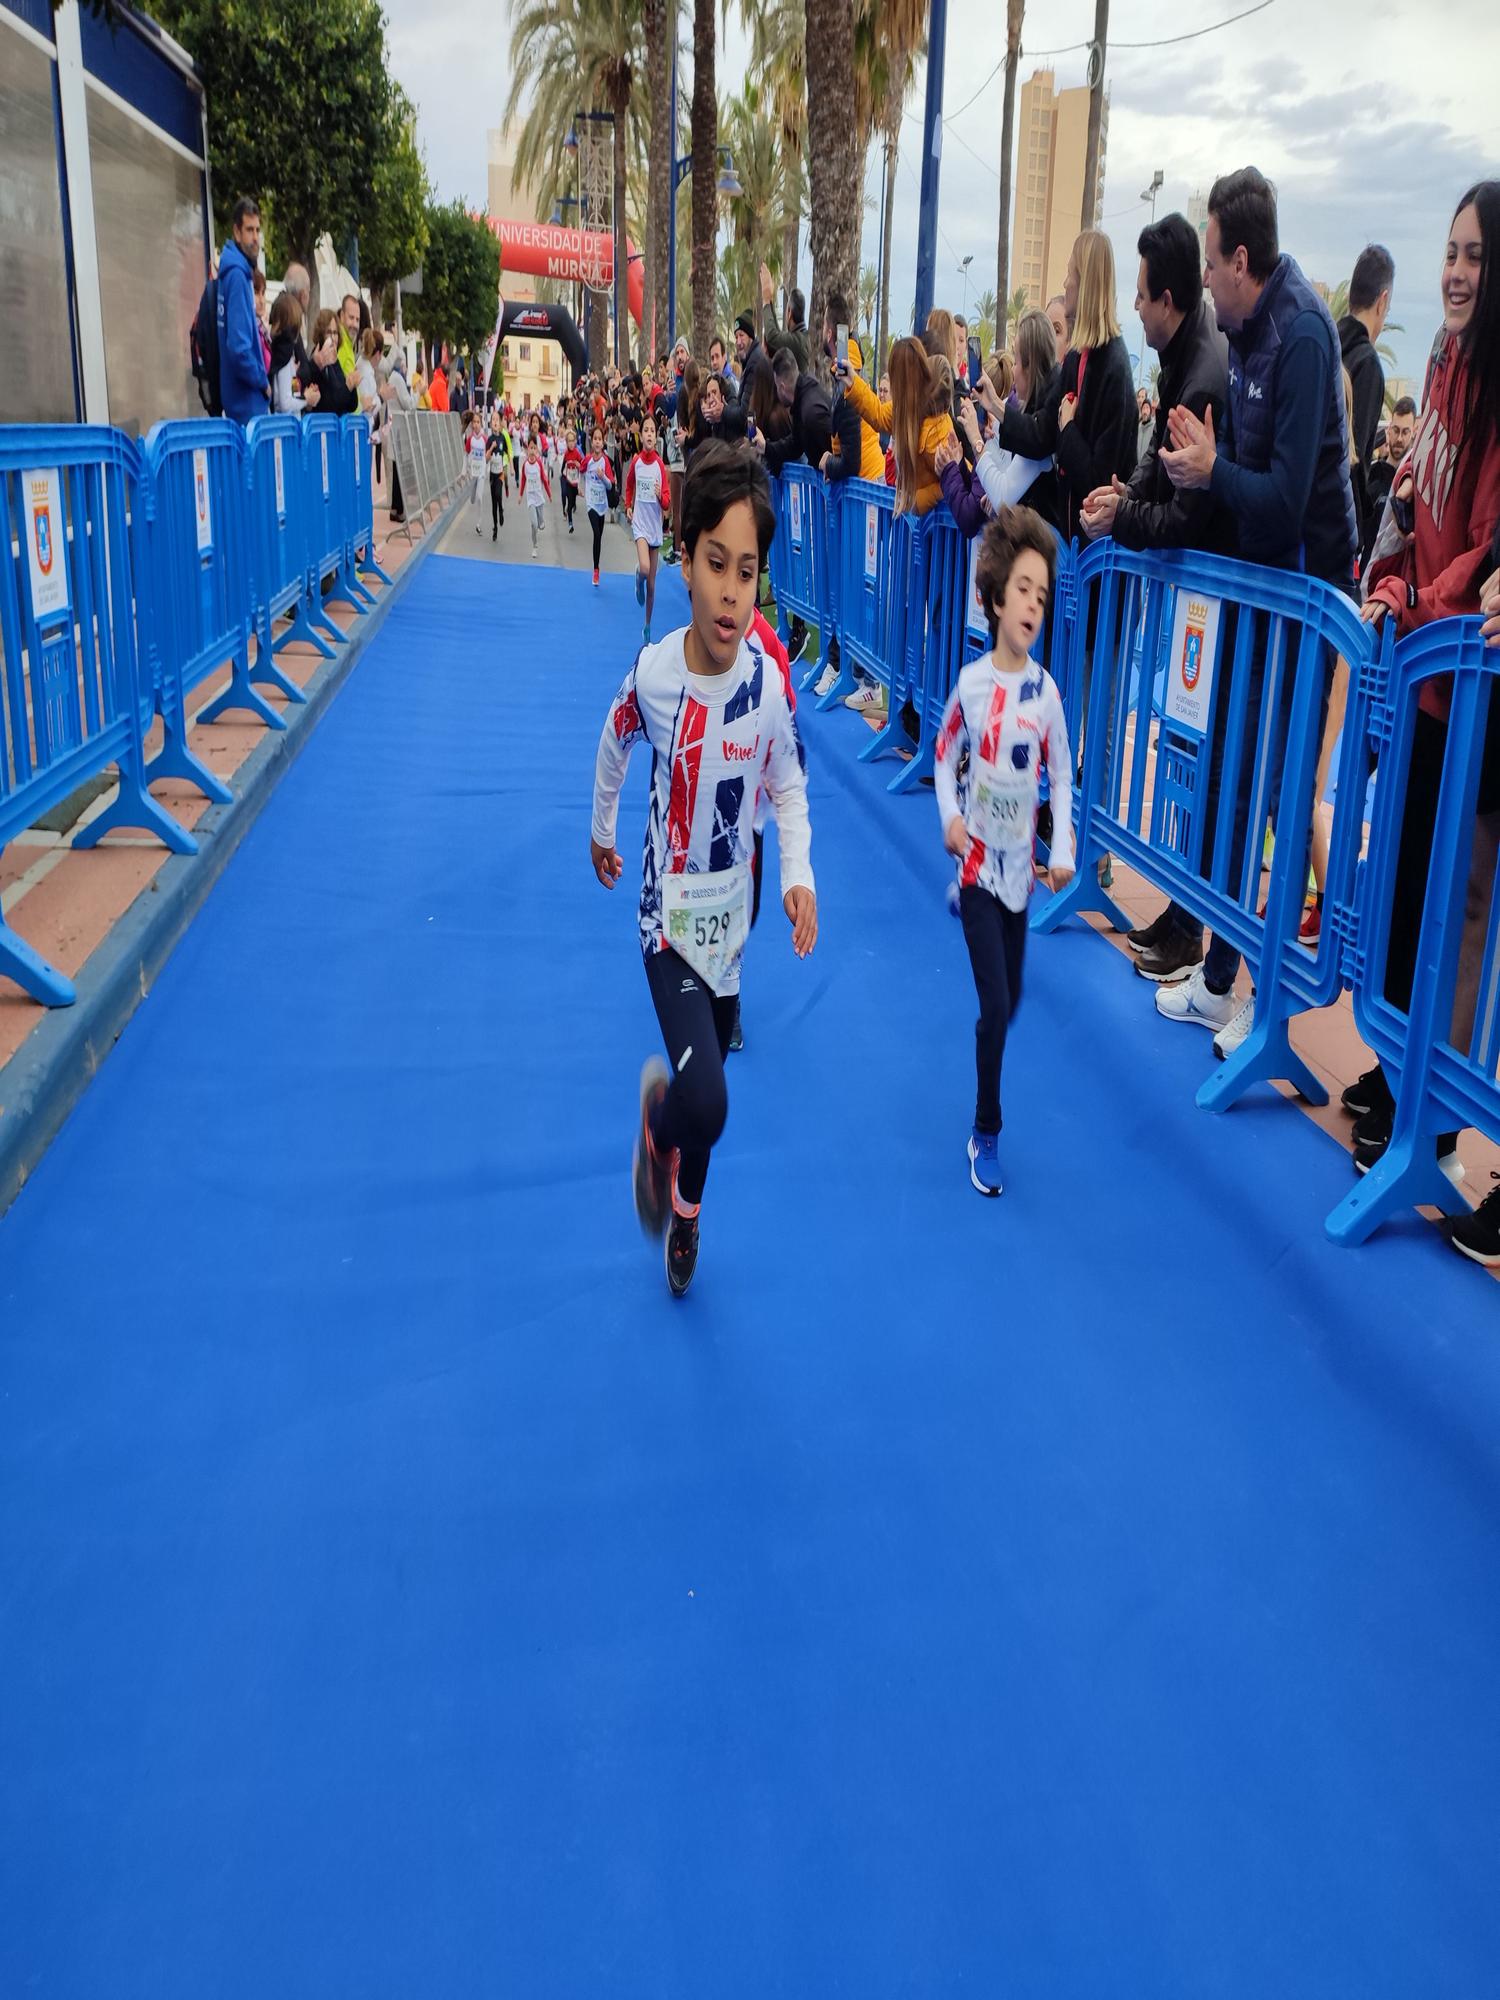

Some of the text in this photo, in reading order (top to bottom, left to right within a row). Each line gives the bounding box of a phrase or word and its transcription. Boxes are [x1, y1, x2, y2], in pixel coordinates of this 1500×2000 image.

[585, 235, 601, 255] DE
[548, 256, 602, 281] MURCIA
[722, 734, 760, 762] Vive!
[695, 911, 730, 947] 529
